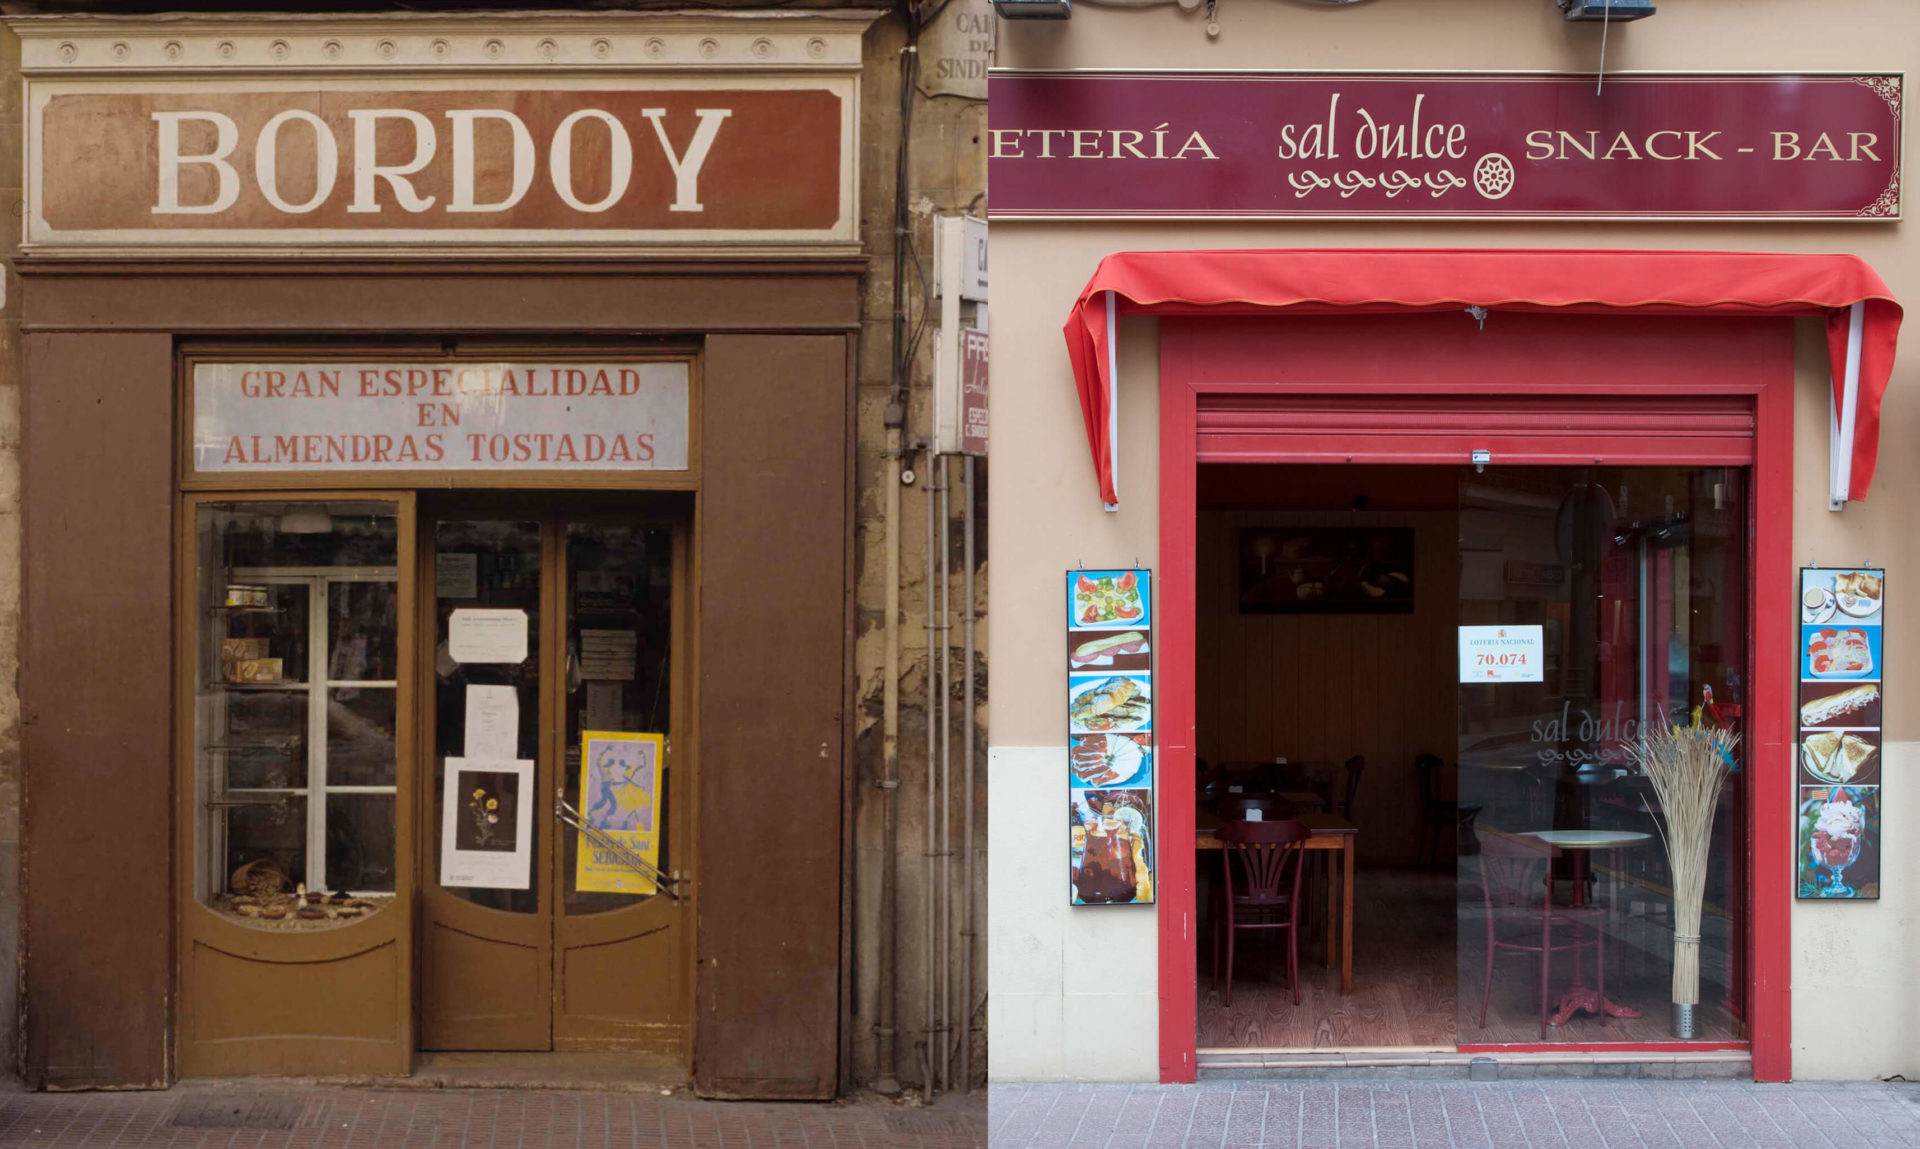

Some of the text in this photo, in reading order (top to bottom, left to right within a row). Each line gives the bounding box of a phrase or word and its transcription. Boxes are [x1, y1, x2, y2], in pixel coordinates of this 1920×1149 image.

[988, 122, 1219, 159] ETERÍA
[1279, 93, 1467, 160] sal dulce
[151, 109, 732, 215] BORDOY
[1525, 130, 1722, 160] SNACK
[1770, 131, 1881, 162] BAR
[240, 368, 641, 398] GRAN ESPECIALIDAD
[417, 403, 460, 427] EN
[223, 433, 656, 464] ALMENDRAS TOSTADAS
[1476, 653, 1527, 665] 70.074
[1531, 700, 1571, 743] sal
